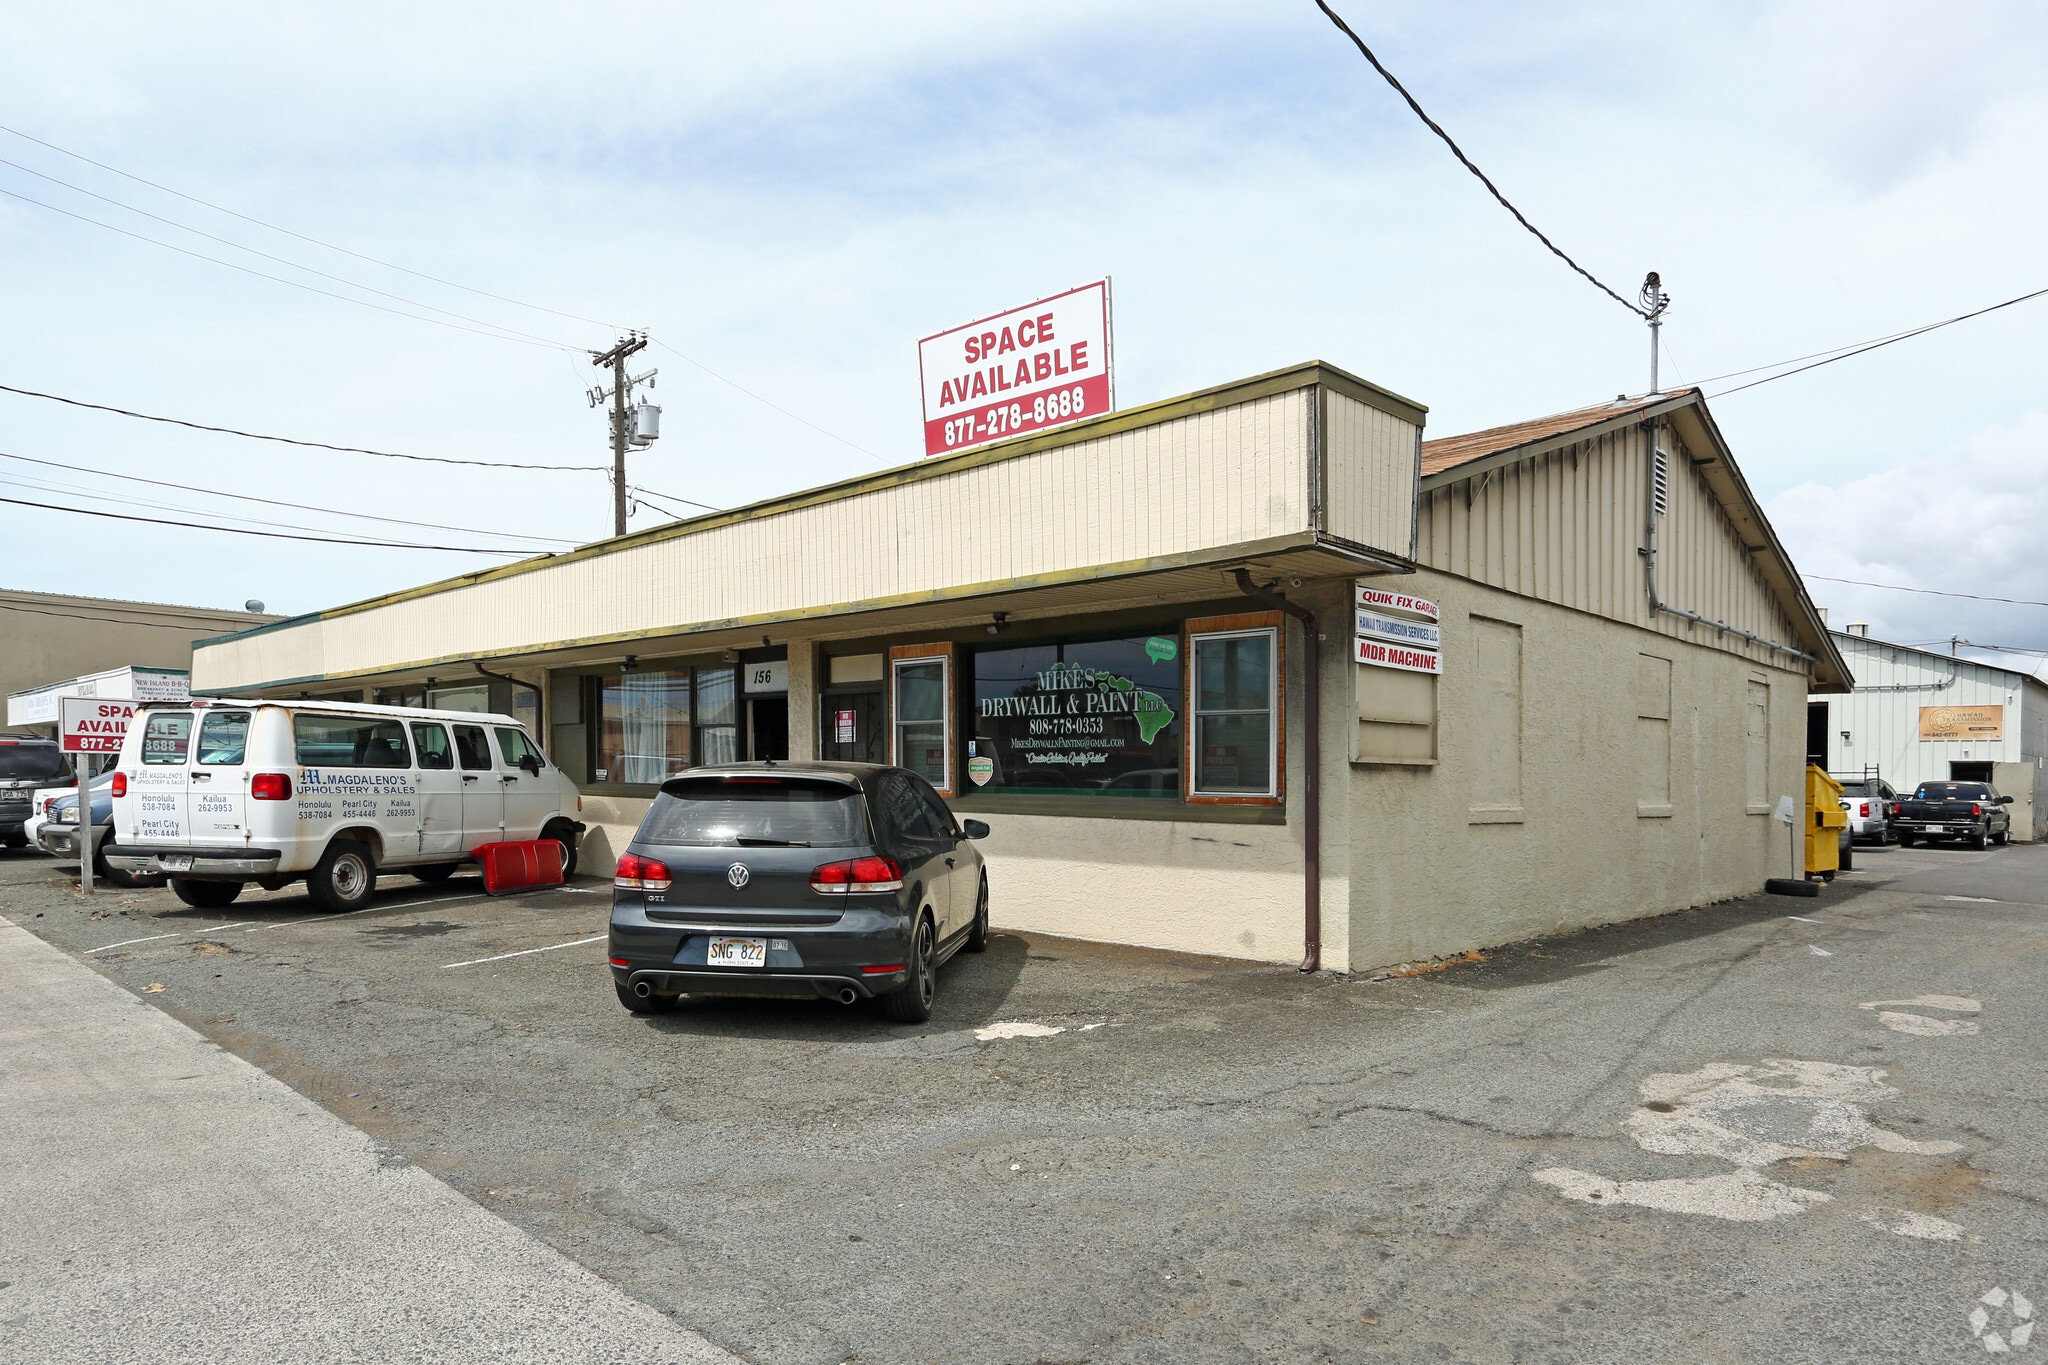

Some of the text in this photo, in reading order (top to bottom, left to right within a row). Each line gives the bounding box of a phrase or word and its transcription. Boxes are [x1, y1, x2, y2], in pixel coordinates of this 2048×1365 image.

[964, 312, 1055, 364] SPACE
[939, 340, 1089, 408] AVAILABLE
[944, 386, 1085, 446] 877-278-8688
[1362, 591, 1438, 617] QUIK FIX GARAGE
[1375, 619, 1408, 636] TRANSMISSION
[1407, 625, 1429, 641] SERVICES
[1360, 642, 1437, 670] MDR MACHINE
[753, 669, 772, 684] 156
[149, 679, 170, 687] ISLAND
[981, 690, 1163, 718] DRYWALL & PAINT LLC
[327, 775, 407, 785] MAGDALENO'S
[296, 786, 416, 794] UPHOLSTERY & SALES
[141, 794, 175, 802] Honolulu
[202, 794, 227, 803] Kailua
[142, 803, 176, 811] 538-7084
[298, 800, 332, 808] Honolulu
[342, 800, 377, 809] Pearl City
[390, 799, 411, 807] Kailua
[198, 804, 233, 812] 262-9953
[298, 811, 332, 819] 538-7084
[342, 810, 376, 818] 455-4446
[386, 809, 415, 817] 262-9953
[142, 820, 180, 829] Pearl City
[143, 829, 180, 837] 455-4446
[710, 943, 764, 960] SNG 822
